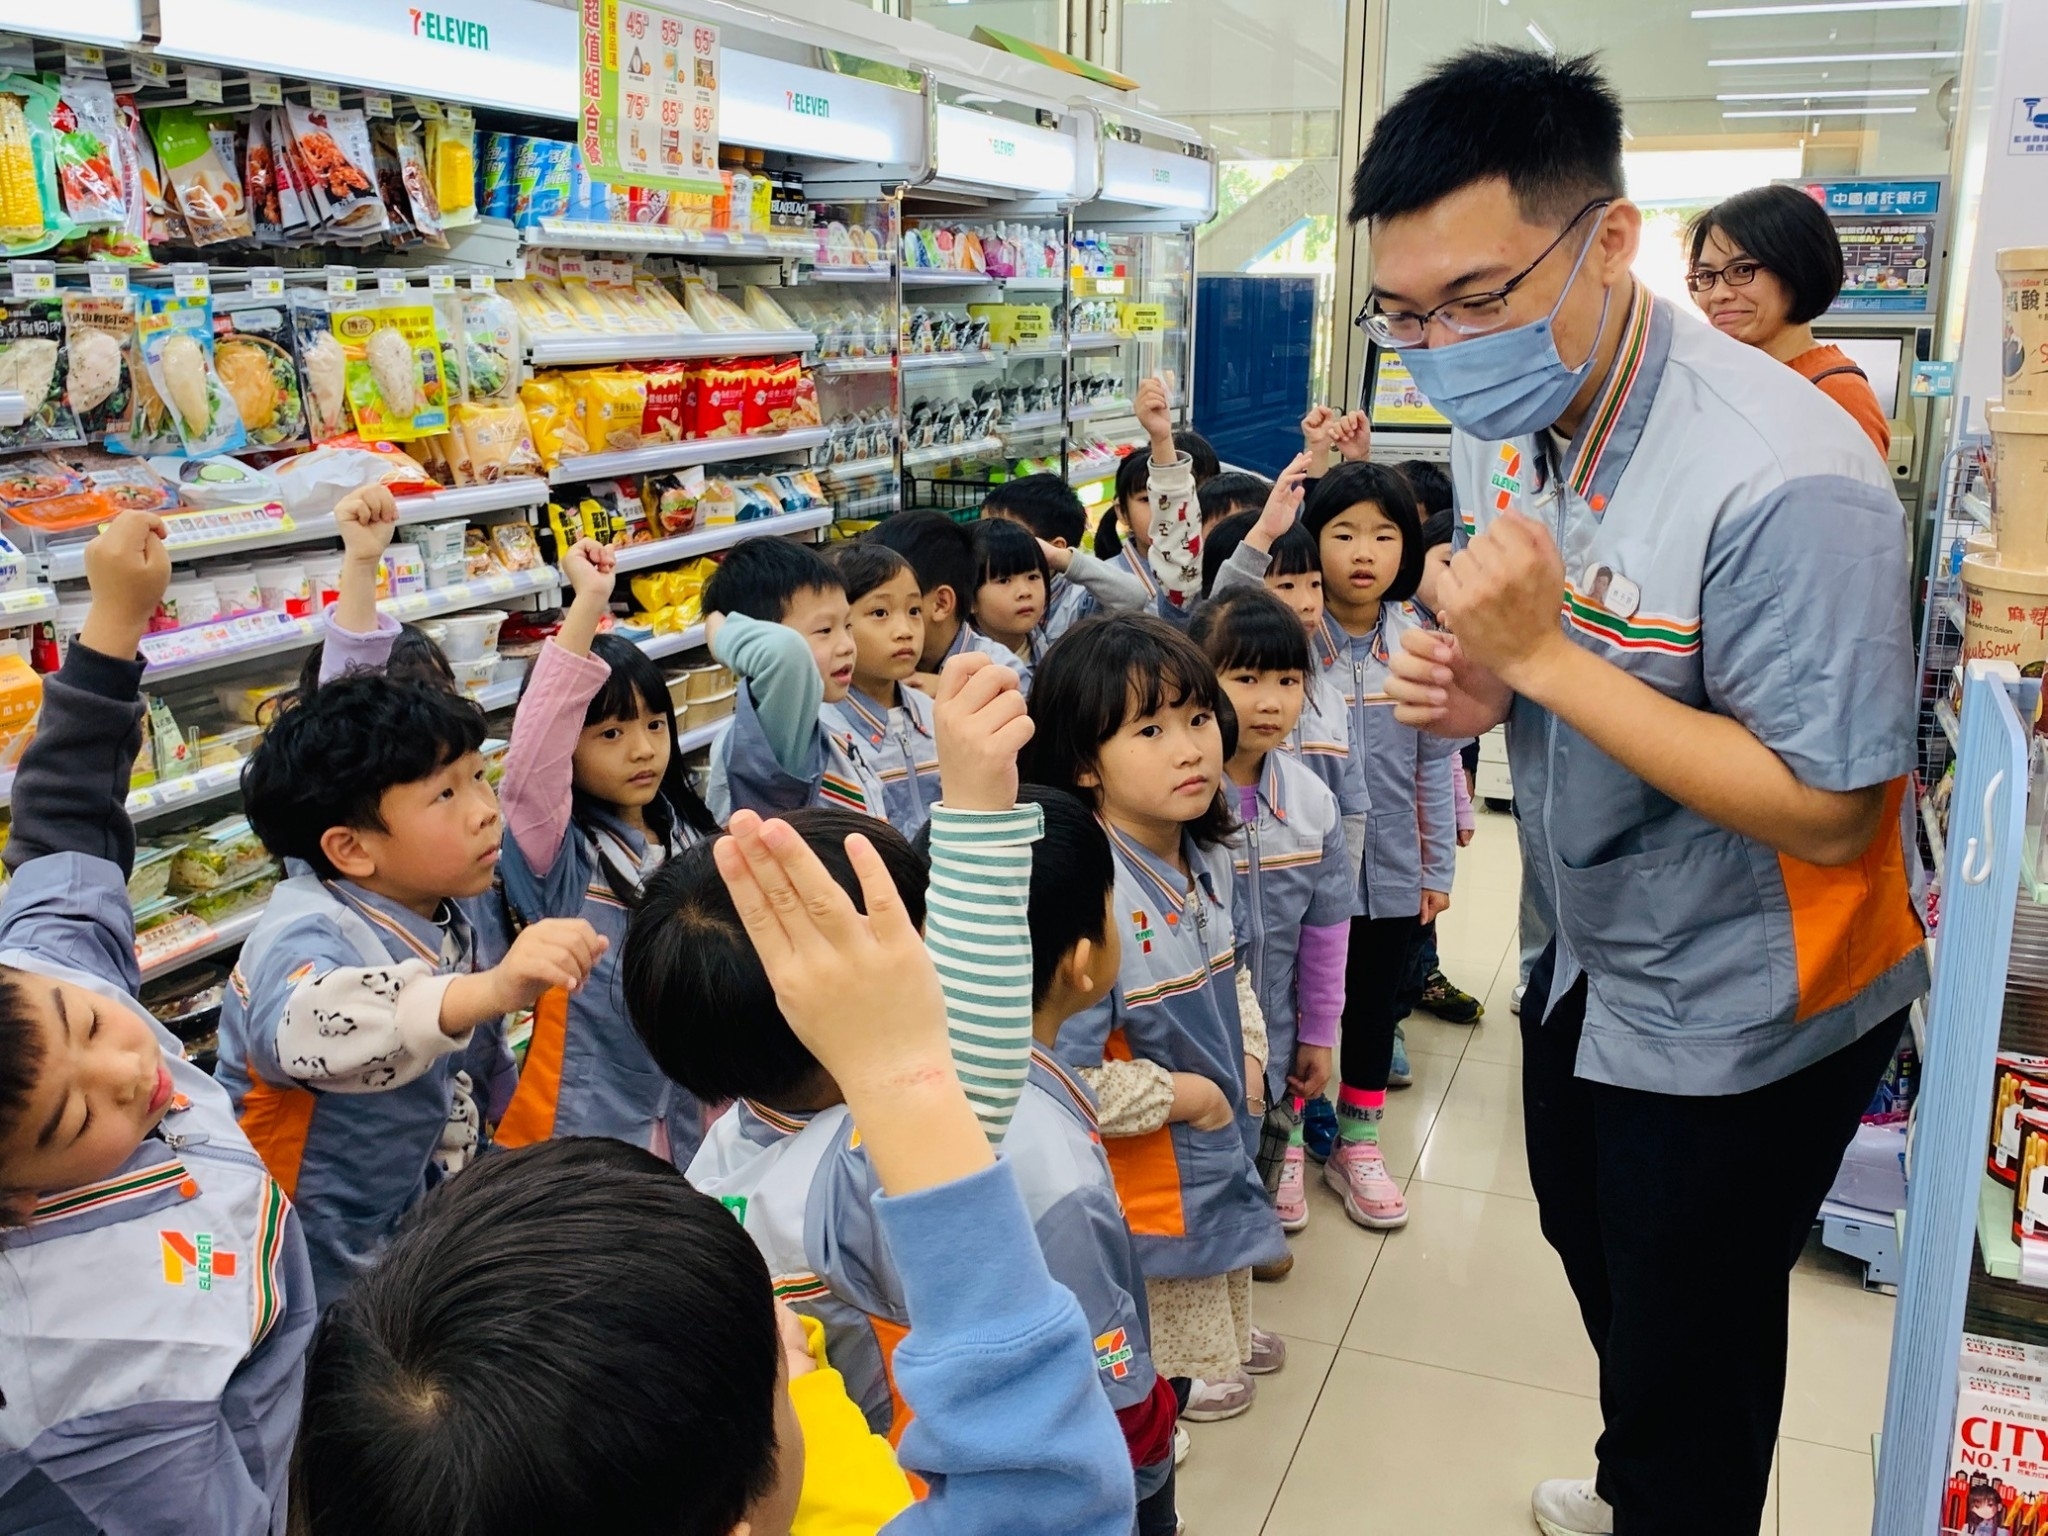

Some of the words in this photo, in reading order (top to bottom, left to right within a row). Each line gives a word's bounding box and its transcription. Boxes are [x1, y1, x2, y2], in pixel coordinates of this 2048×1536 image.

[1833, 191, 1927, 206] 中國信託銀行
[40, 277, 50, 287] 59
[1994, 626, 2013, 635] Onion
[1978, 1366, 2010, 1377] ARITA
[1982, 1404, 2015, 1417] ARITA
[1961, 1448, 2011, 1473] NO.1
